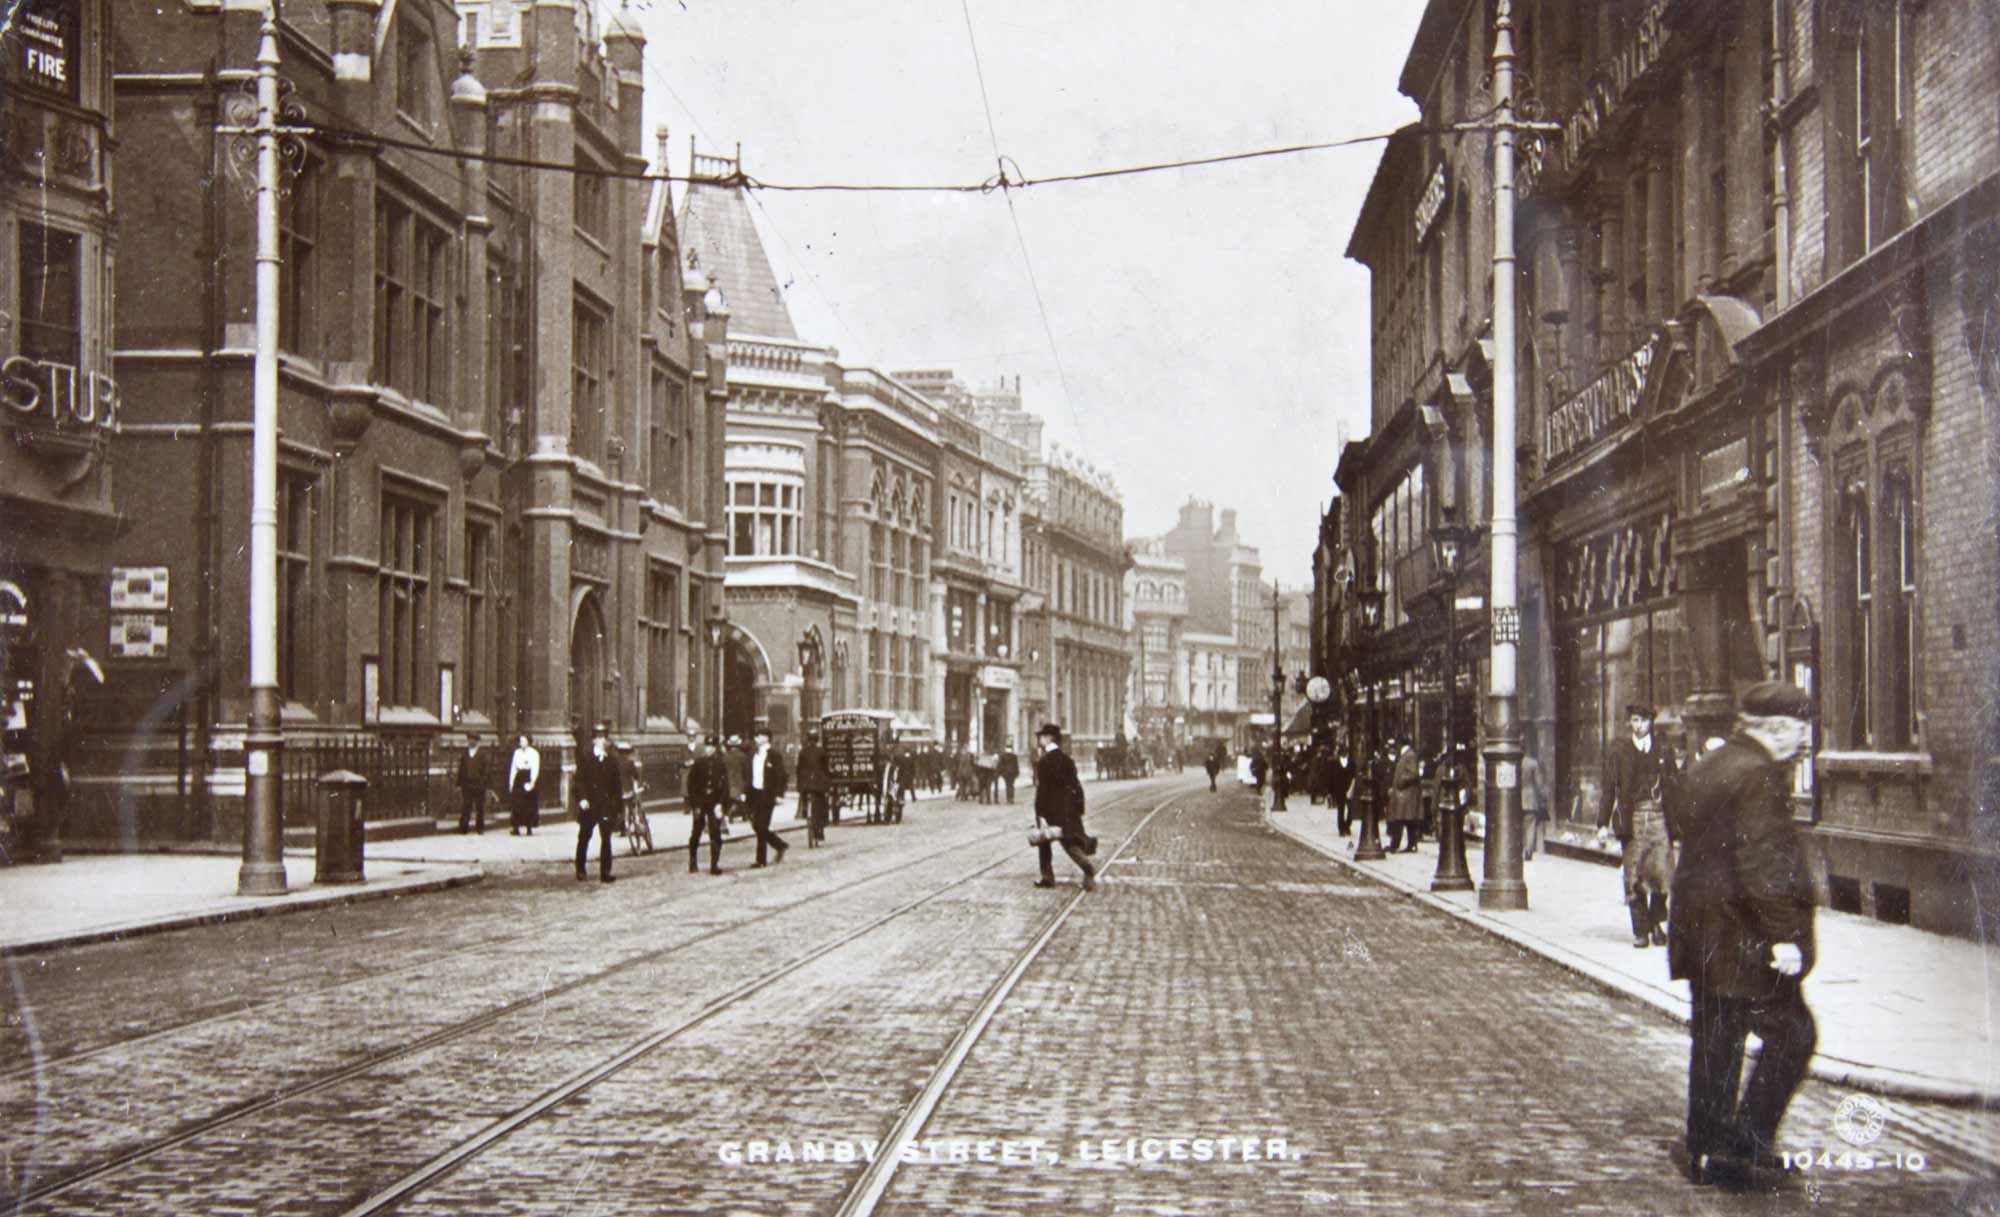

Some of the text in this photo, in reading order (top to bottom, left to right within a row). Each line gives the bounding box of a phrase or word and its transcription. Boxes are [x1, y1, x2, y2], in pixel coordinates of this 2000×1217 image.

[27, 48, 67, 82] FIRE
[1495, 615, 1519, 624] CARS
[1495, 624, 1520, 632] STOP
[1495, 632, 1520, 641] HERE
